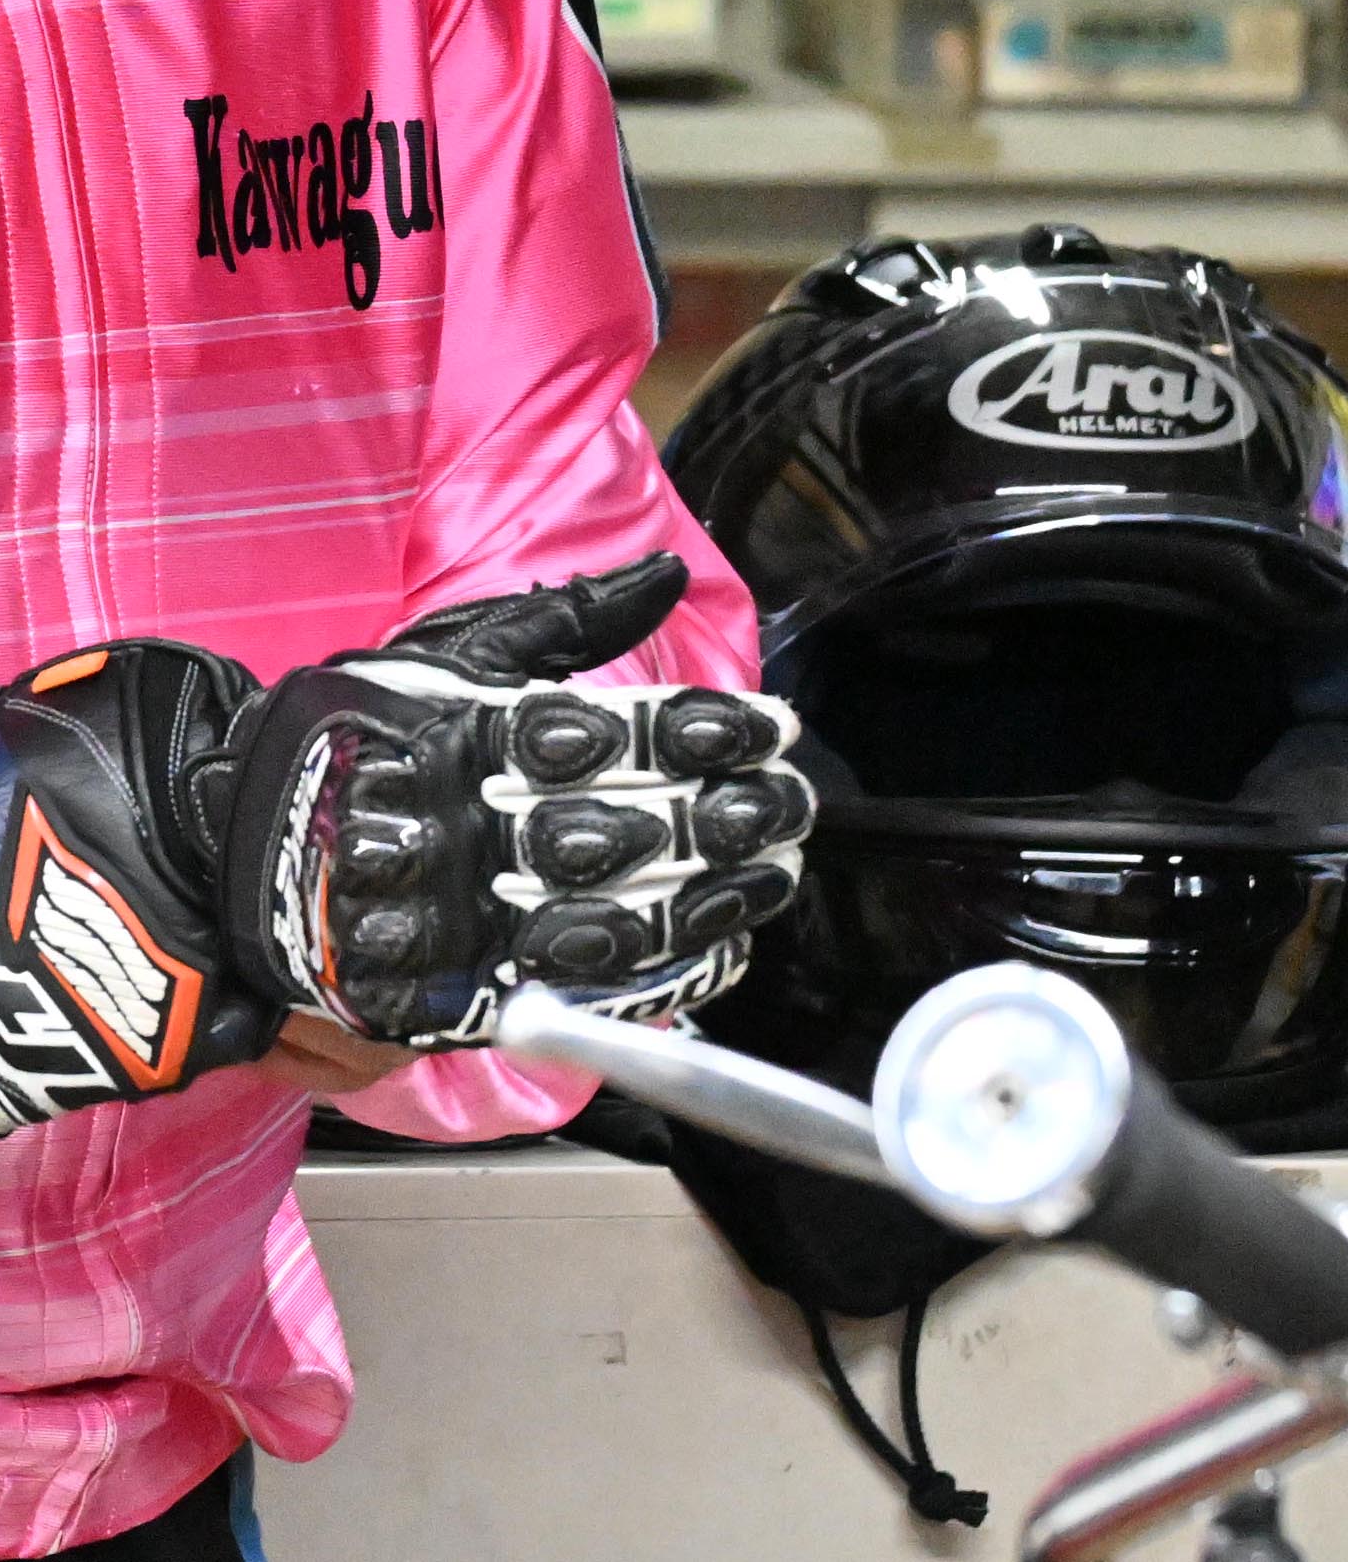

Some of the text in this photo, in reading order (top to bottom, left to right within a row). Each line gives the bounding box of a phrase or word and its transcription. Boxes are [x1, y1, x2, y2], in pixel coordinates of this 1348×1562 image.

[183, 89, 446, 311] Kawagu
[971, 339, 1228, 425] Arai
[1058, 414, 1176, 436] HELMET
